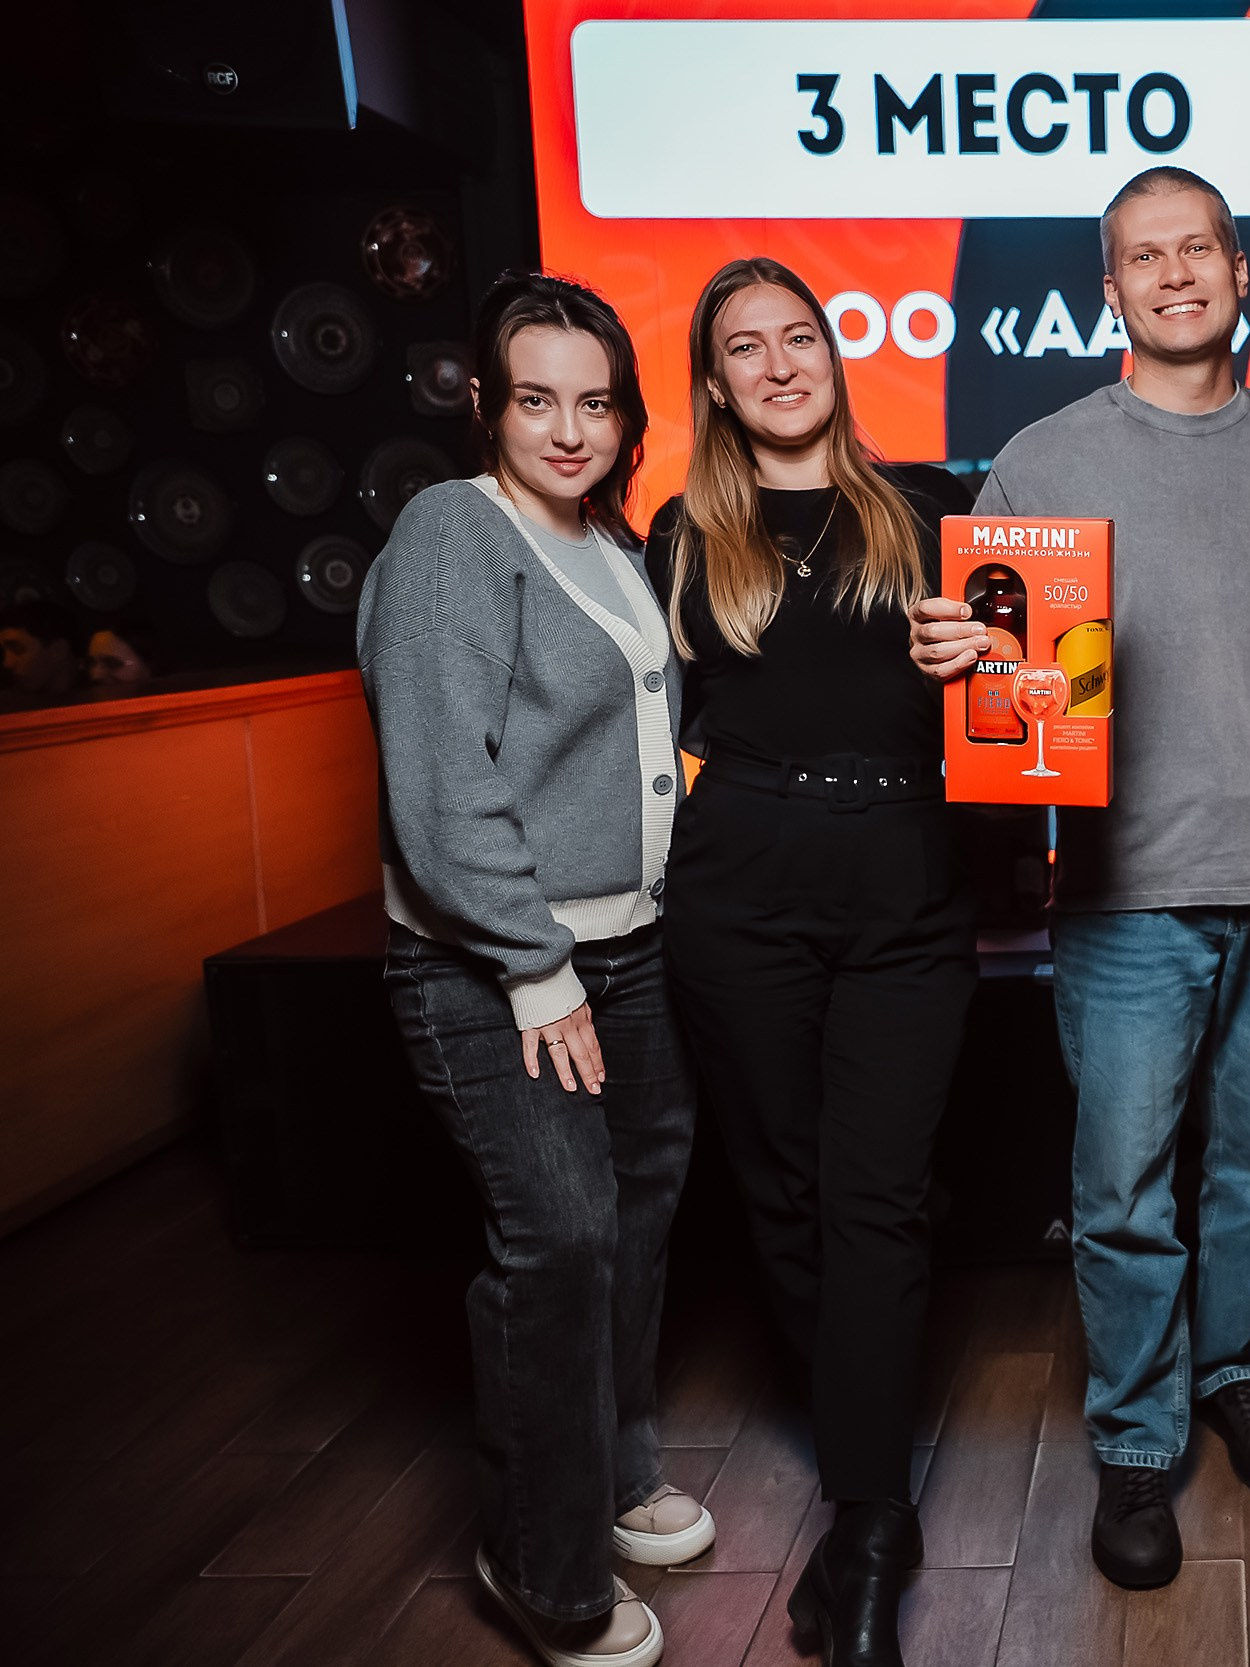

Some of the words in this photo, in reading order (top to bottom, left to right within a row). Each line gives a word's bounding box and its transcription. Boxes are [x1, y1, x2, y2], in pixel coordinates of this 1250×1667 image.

[207, 72, 234, 85] RCF
[797, 73, 845, 155] 3
[874, 72, 1192, 155] МЕСТО
[824, 290, 957, 360] ОО
[973, 526, 1077, 549] MARTINI
[957, 547, 981, 555] ВКУС
[983, 548, 1054, 557] ИТАЛЬЯНСКОЙ
[1044, 585, 1088, 603] 50/50
[976, 661, 1018, 675] ARTIN
